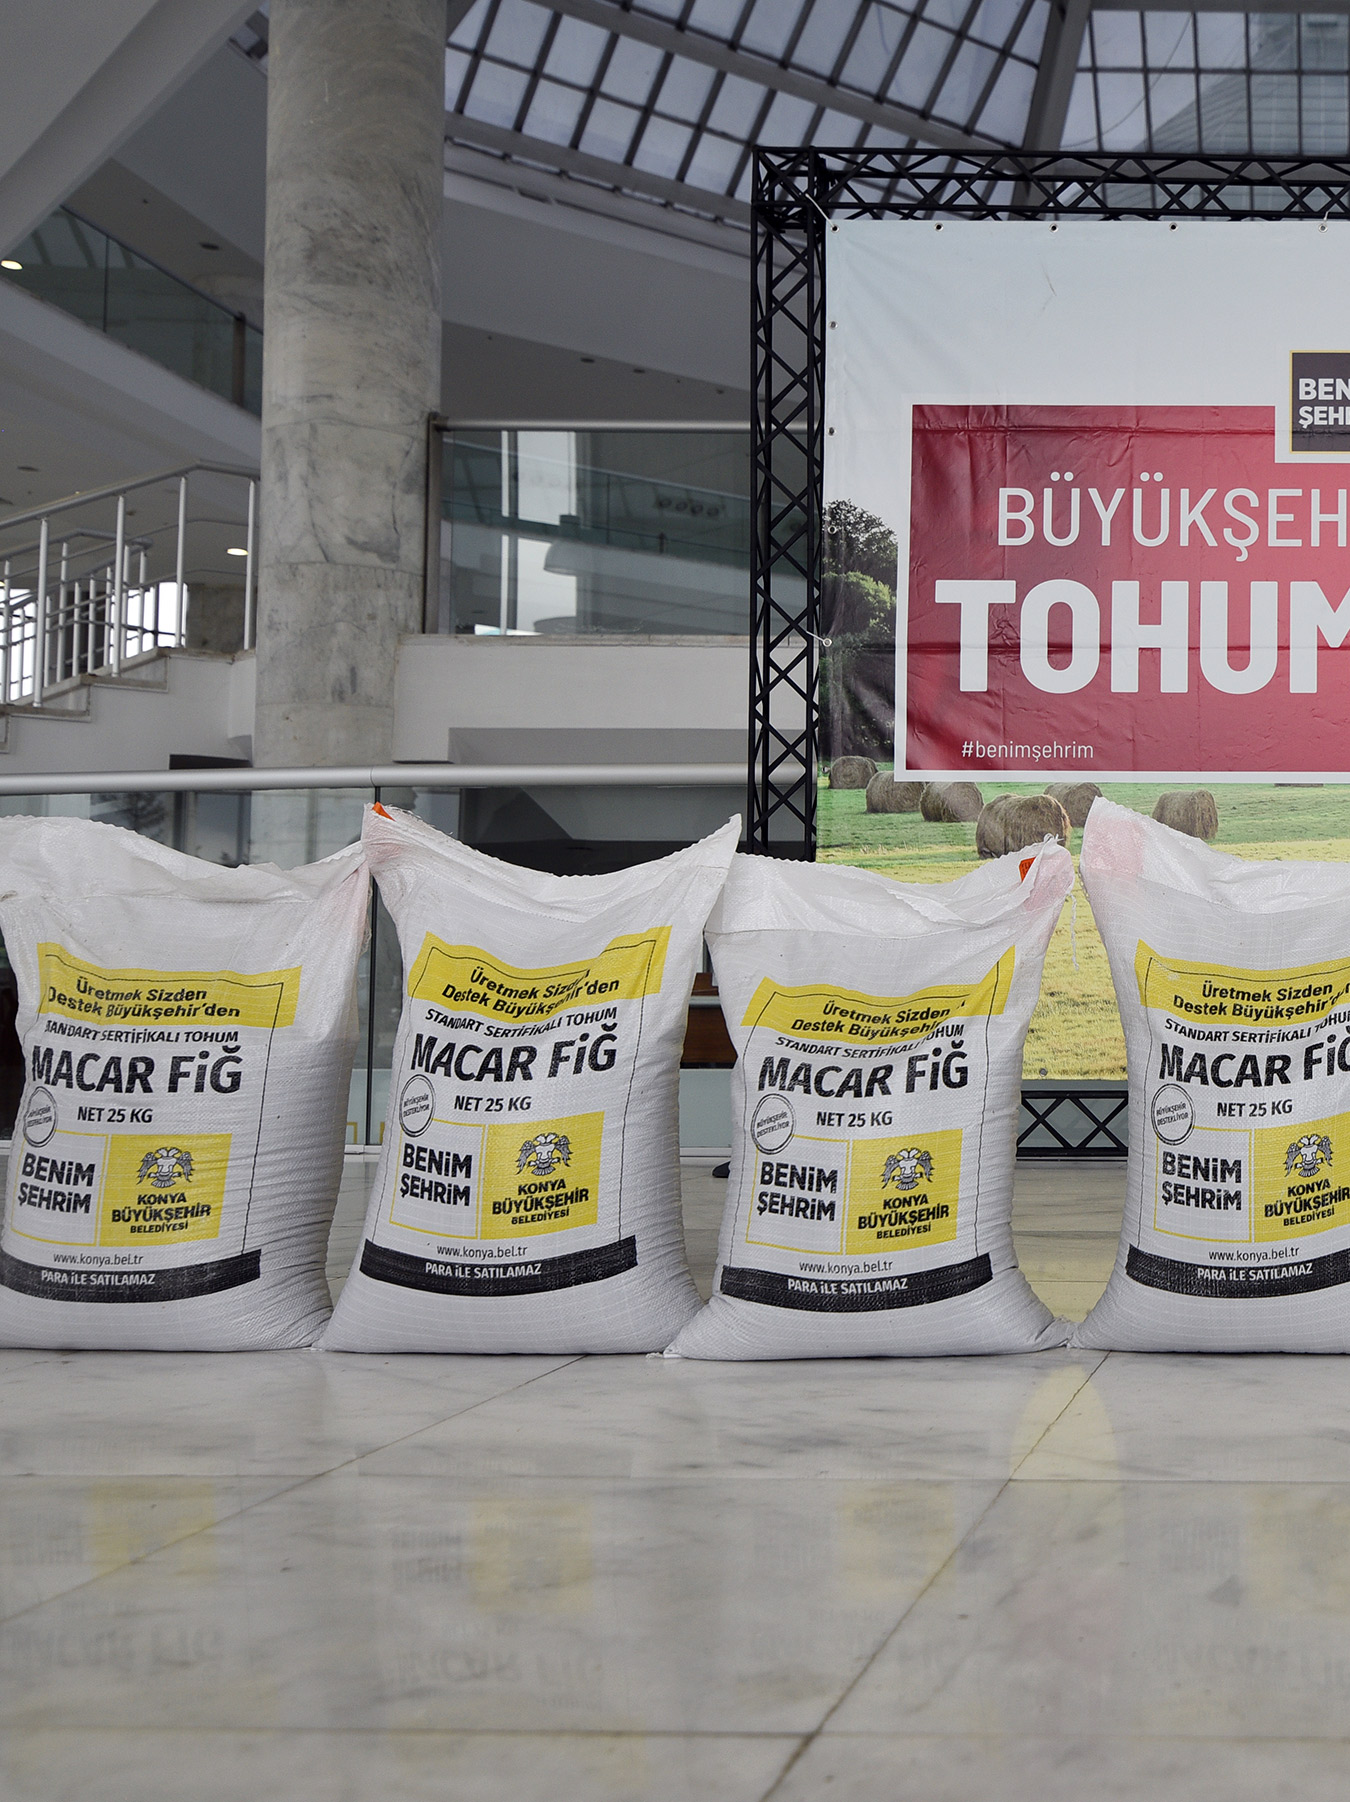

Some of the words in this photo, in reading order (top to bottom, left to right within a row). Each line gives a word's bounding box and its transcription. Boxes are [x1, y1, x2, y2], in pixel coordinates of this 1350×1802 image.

[961, 740, 1095, 763] #benimşehrim
[77, 976, 141, 1000] Üretmek
[146, 987, 206, 1000] Sizden
[470, 966, 538, 1000] Üretmek
[1202, 980, 1271, 1001] Üretmek
[1276, 983, 1332, 1000] Sizden
[442, 984, 489, 1006] Destek
[823, 1000, 890, 1024] Üretmek
[895, 1007, 950, 1022] Sizden
[1174, 996, 1227, 1016] Destek
[425, 1008, 482, 1032] STANDART
[567, 1007, 617, 1026] TOHUM
[791, 1019, 843, 1033] Destek
[184, 1031, 238, 1042] TOHUM
[1164, 1018, 1230, 1042] STANDART
[776, 1036, 840, 1056] STANDART
[411, 1033, 537, 1082] MACAR
[1160, 1043, 1291, 1088] MACAR
[32, 1046, 154, 1093] MACAR
[758, 1056, 892, 1098] MACAR
[454, 1096, 482, 1111] NET
[485, 1098, 503, 1112] 25
[508, 1096, 531, 1110] KG
[1217, 1102, 1245, 1117] NET
[1249, 1102, 1267, 1117] 25
[1271, 1099, 1293, 1115] KG
[78, 1106, 104, 1122] NET
[108, 1108, 125, 1122] 25
[130, 1109, 152, 1122] KG
[816, 1112, 844, 1127] NET
[848, 1114, 866, 1127] 25
[870, 1111, 892, 1126] KG
[518, 1179, 566, 1195] KONYA
[1288, 1179, 1330, 1198] KONYA
[138, 1192, 187, 1205] KONYA
[492, 1188, 589, 1215] BÜYÜKŞEHİR
[883, 1194, 928, 1209] KONYA
[1264, 1188, 1350, 1218] BÜYÜKŞEHİR
[112, 1203, 211, 1223] BÜYÜKŞEHİR
[511, 1208, 569, 1224] BELEDİYESİ
[858, 1204, 949, 1230] BÜYÜKŞEHİR
[1283, 1208, 1334, 1226] BELEDİYESİ
[130, 1221, 188, 1233] BELEDİYESİ
[877, 1222, 931, 1240] BELEDİYESİ
[54, 1253, 143, 1268] www.konya.bel.tr
[437, 1244, 528, 1260] www.konya.bel.tr
[1209, 1247, 1300, 1262] www.konya.bel.tr
[426, 1262, 453, 1276] PARA
[474, 1264, 542, 1279] SATILAMAZ
[799, 1260, 893, 1276] www.konya.bel.tr
[1198, 1267, 1226, 1280] PARA
[1249, 1264, 1312, 1281] SATILAMAZ
[41, 1270, 68, 1282] PARA
[90, 1273, 156, 1285] SATILAMAZ
[788, 1279, 817, 1292] PARA
[841, 1279, 908, 1294] SATILAMAZ
